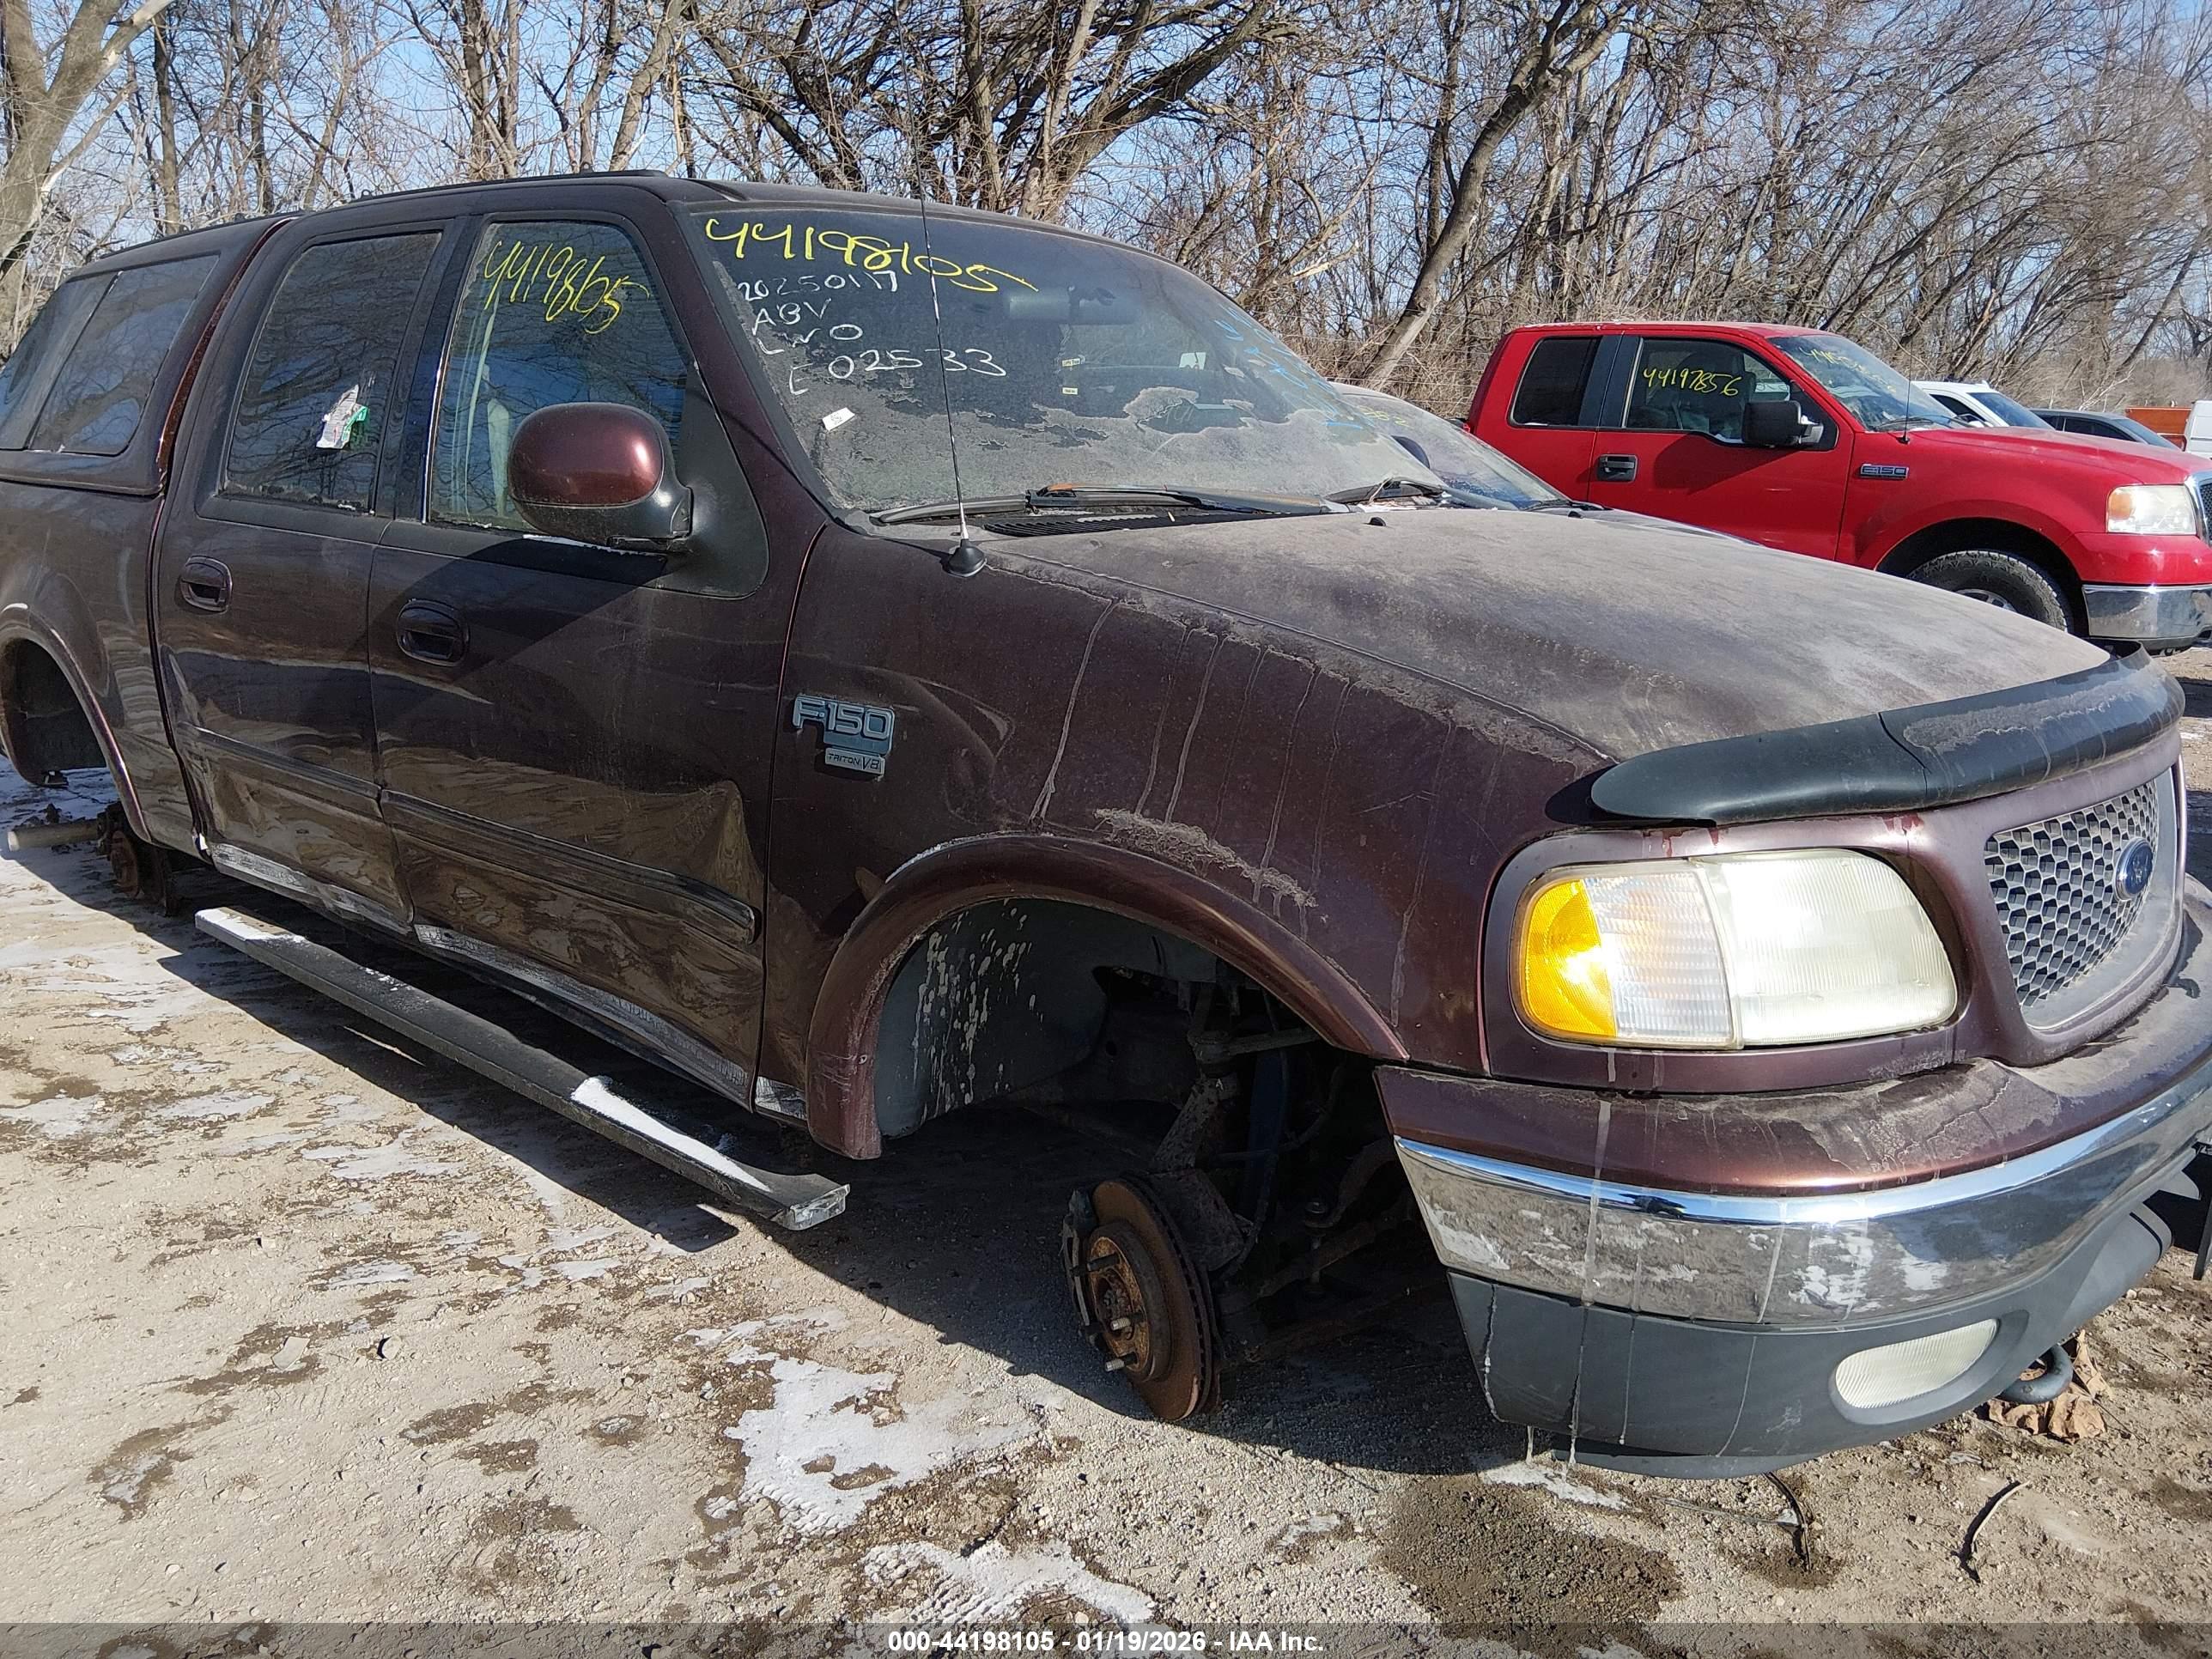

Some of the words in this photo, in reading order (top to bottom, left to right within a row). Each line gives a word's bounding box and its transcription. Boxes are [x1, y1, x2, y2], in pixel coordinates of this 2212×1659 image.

[706, 217, 1039, 293] 44198105
[1643, 368, 1742, 396] 44197856
[828, 752, 860, 765] TRITON
[862, 756, 880, 770] V8
